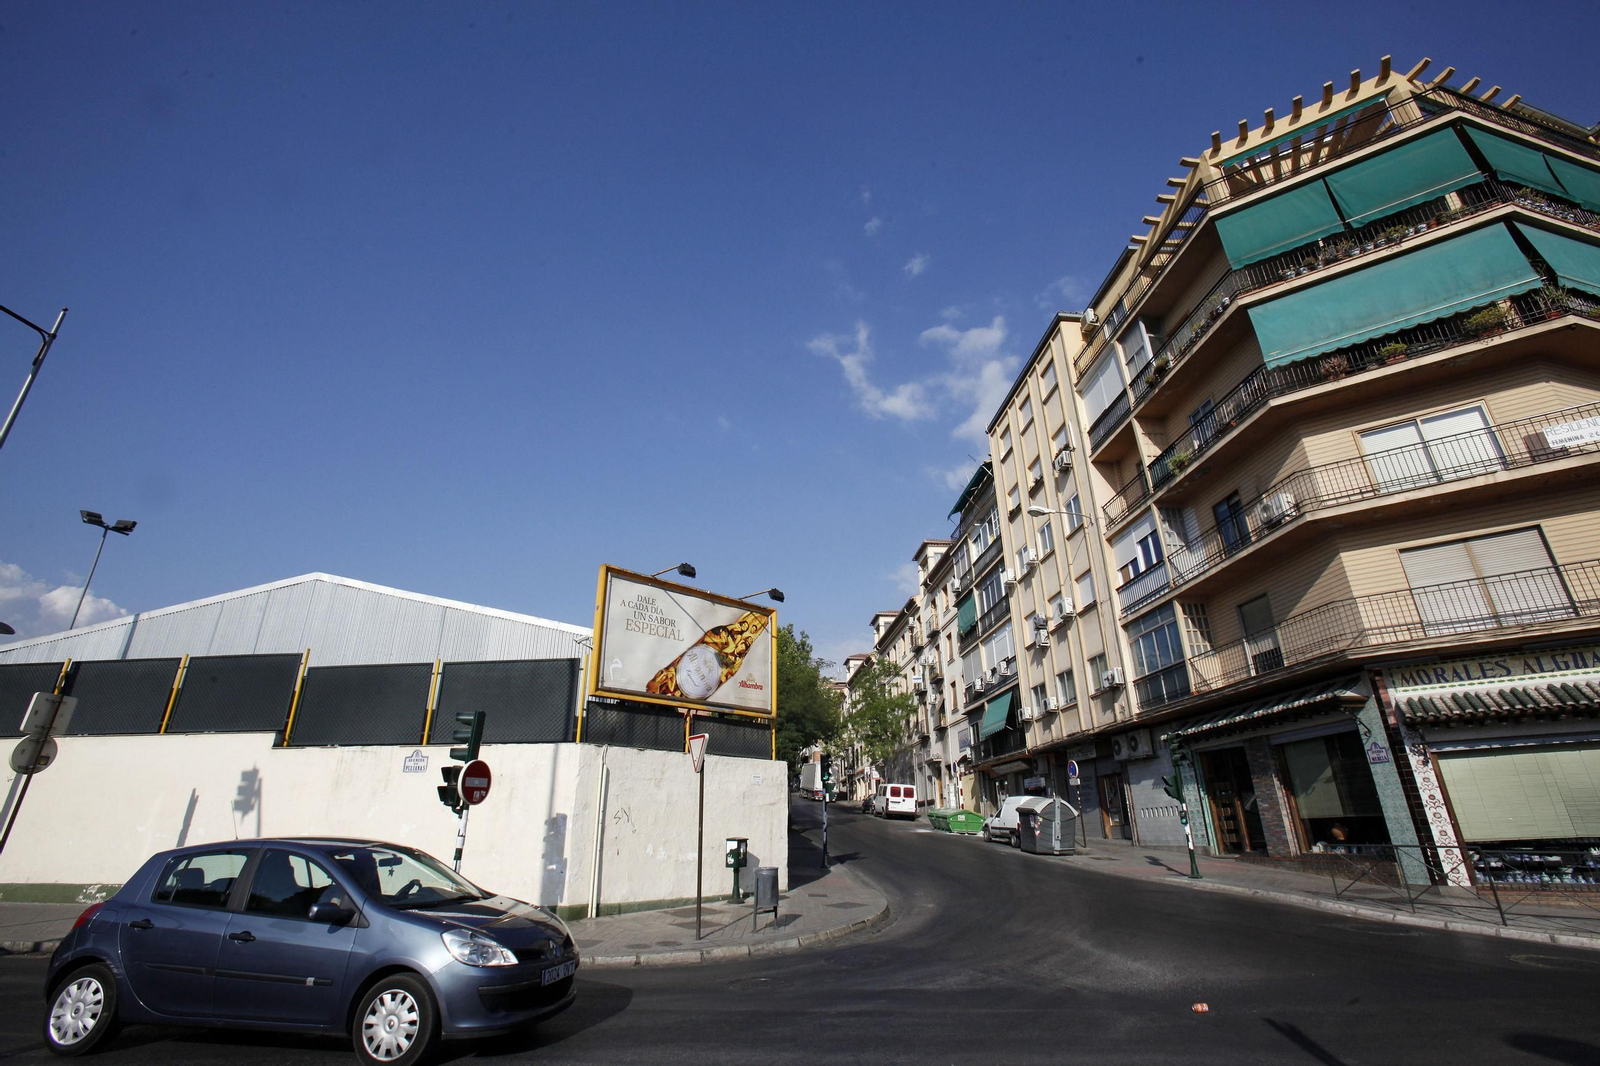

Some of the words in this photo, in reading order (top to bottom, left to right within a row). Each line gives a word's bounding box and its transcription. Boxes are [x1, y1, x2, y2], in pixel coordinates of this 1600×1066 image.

[1551, 434, 1585, 445] FEMENINA
[620, 599, 626, 607] A
[628, 600, 649, 612] CADA
[650, 606, 664, 616] DÍA
[637, 594, 657, 606] DALE
[633, 610, 647, 621] UN
[648, 614, 677, 628] SABOR
[625, 618, 685, 642] ESPECIAL
[1400, 658, 1512, 687] MORALES
[738, 680, 763, 690] Alhambra
